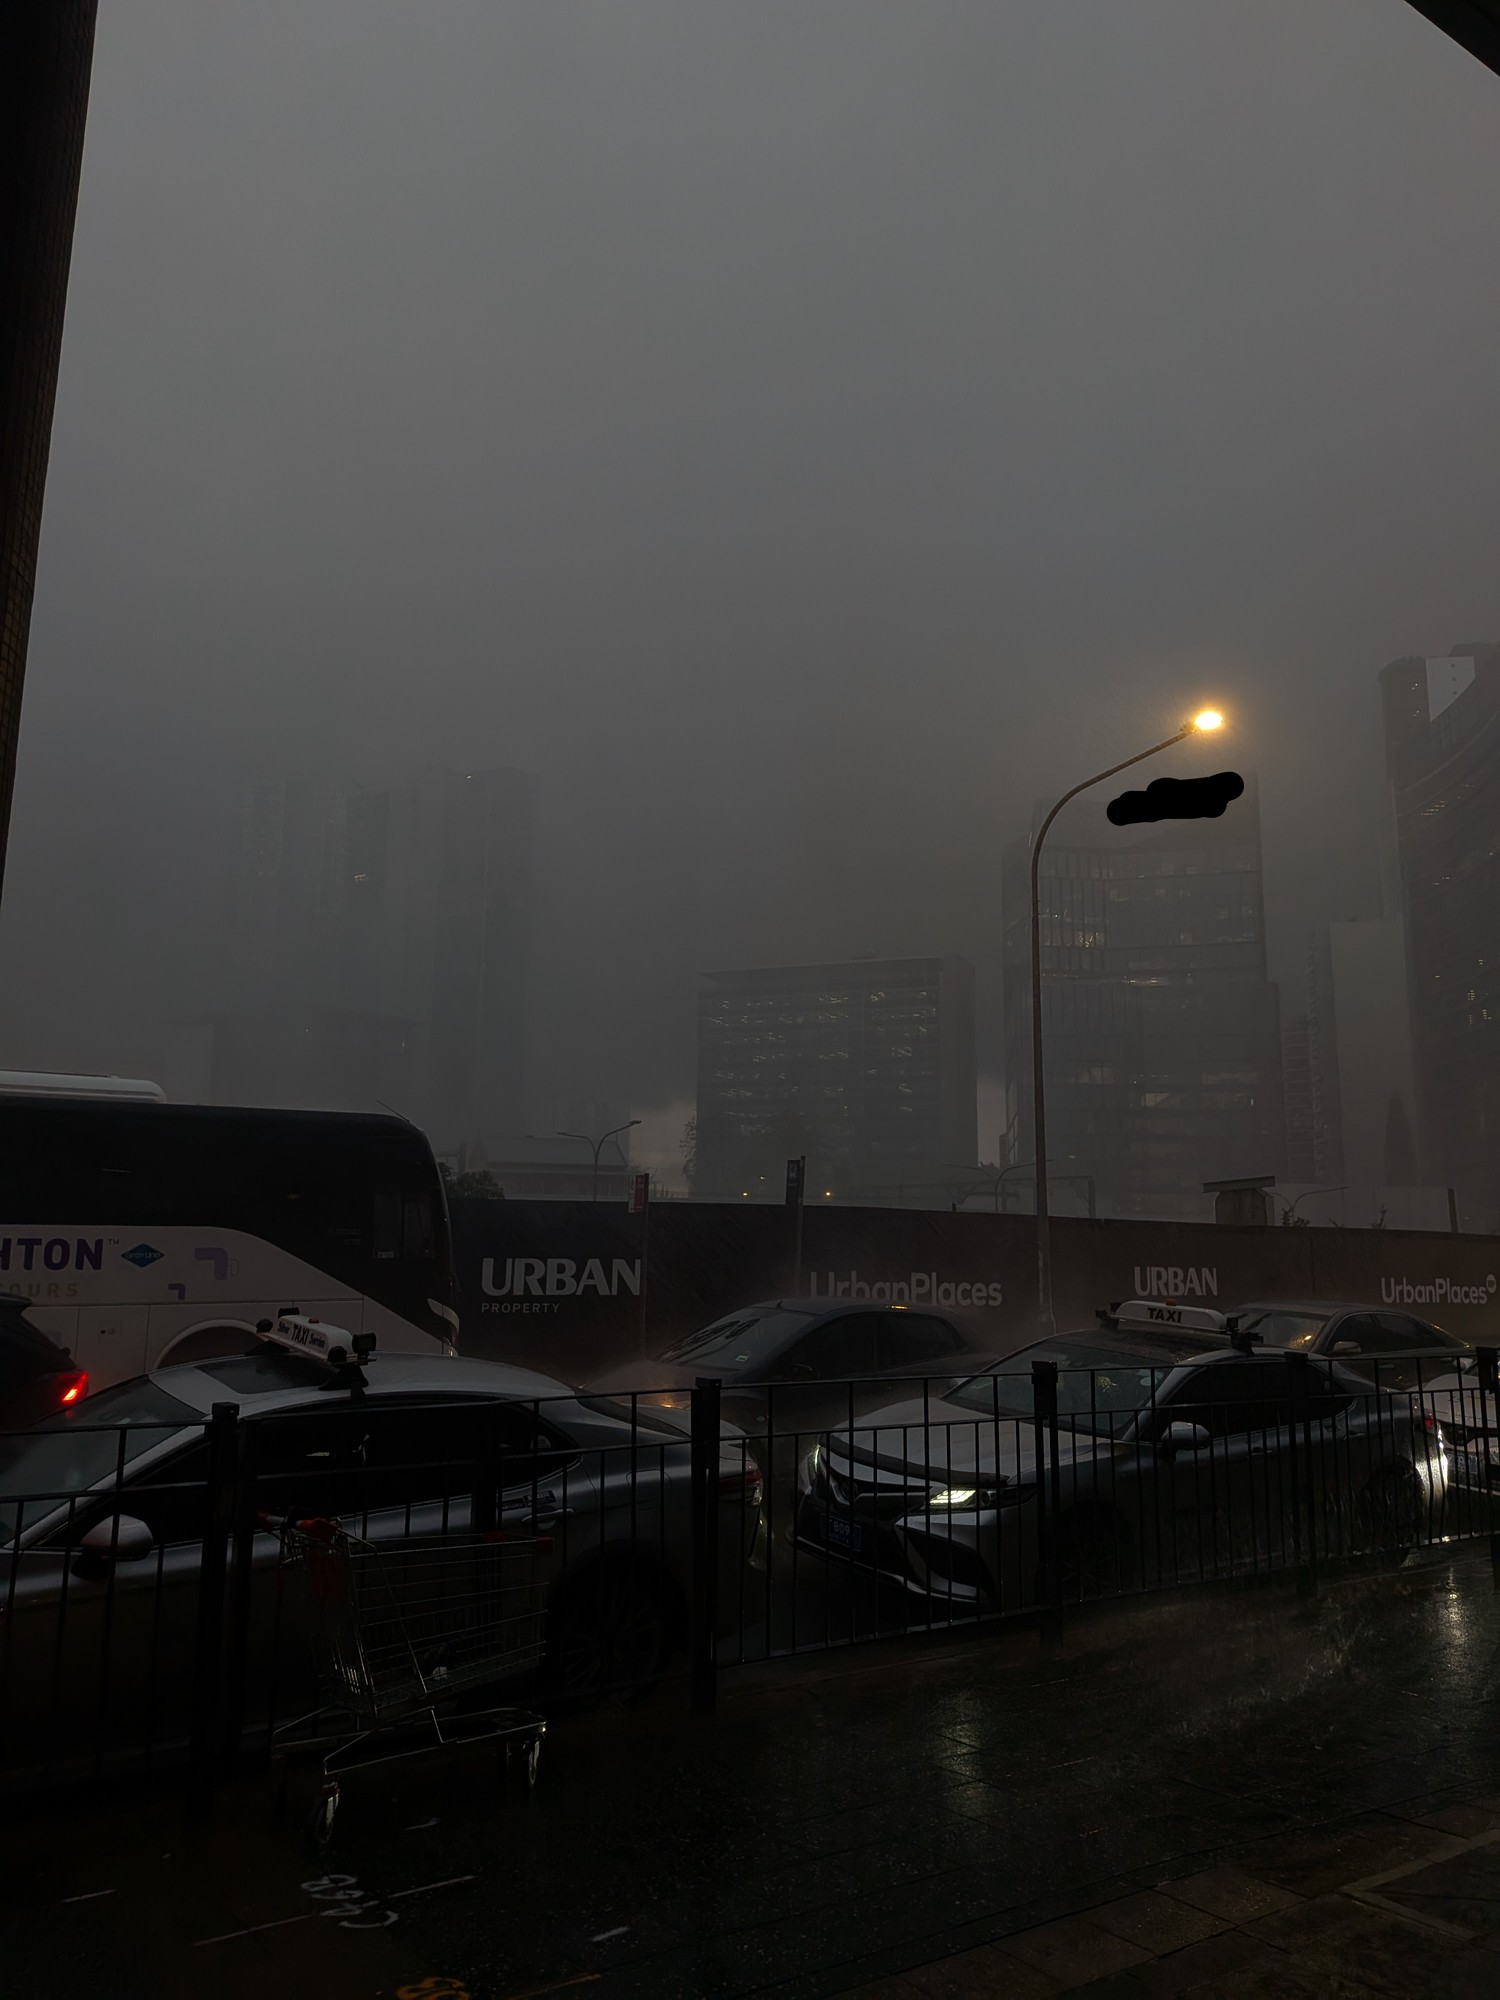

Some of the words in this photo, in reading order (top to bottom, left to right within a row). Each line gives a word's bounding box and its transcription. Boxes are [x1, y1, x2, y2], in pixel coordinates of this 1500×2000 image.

[0, 1282, 78, 1297] OURS
[481, 1257, 641, 1297] URBAN
[810, 1270, 1003, 1307] UrbanPlaces
[1134, 1266, 1218, 1297] URBAN
[1381, 1276, 1488, 1304] UrbanPlaces
[481, 1302, 560, 1314] PROPERTY
[1147, 1307, 1182, 1323] TAXI
[291, 1323, 310, 1346] TAXI
